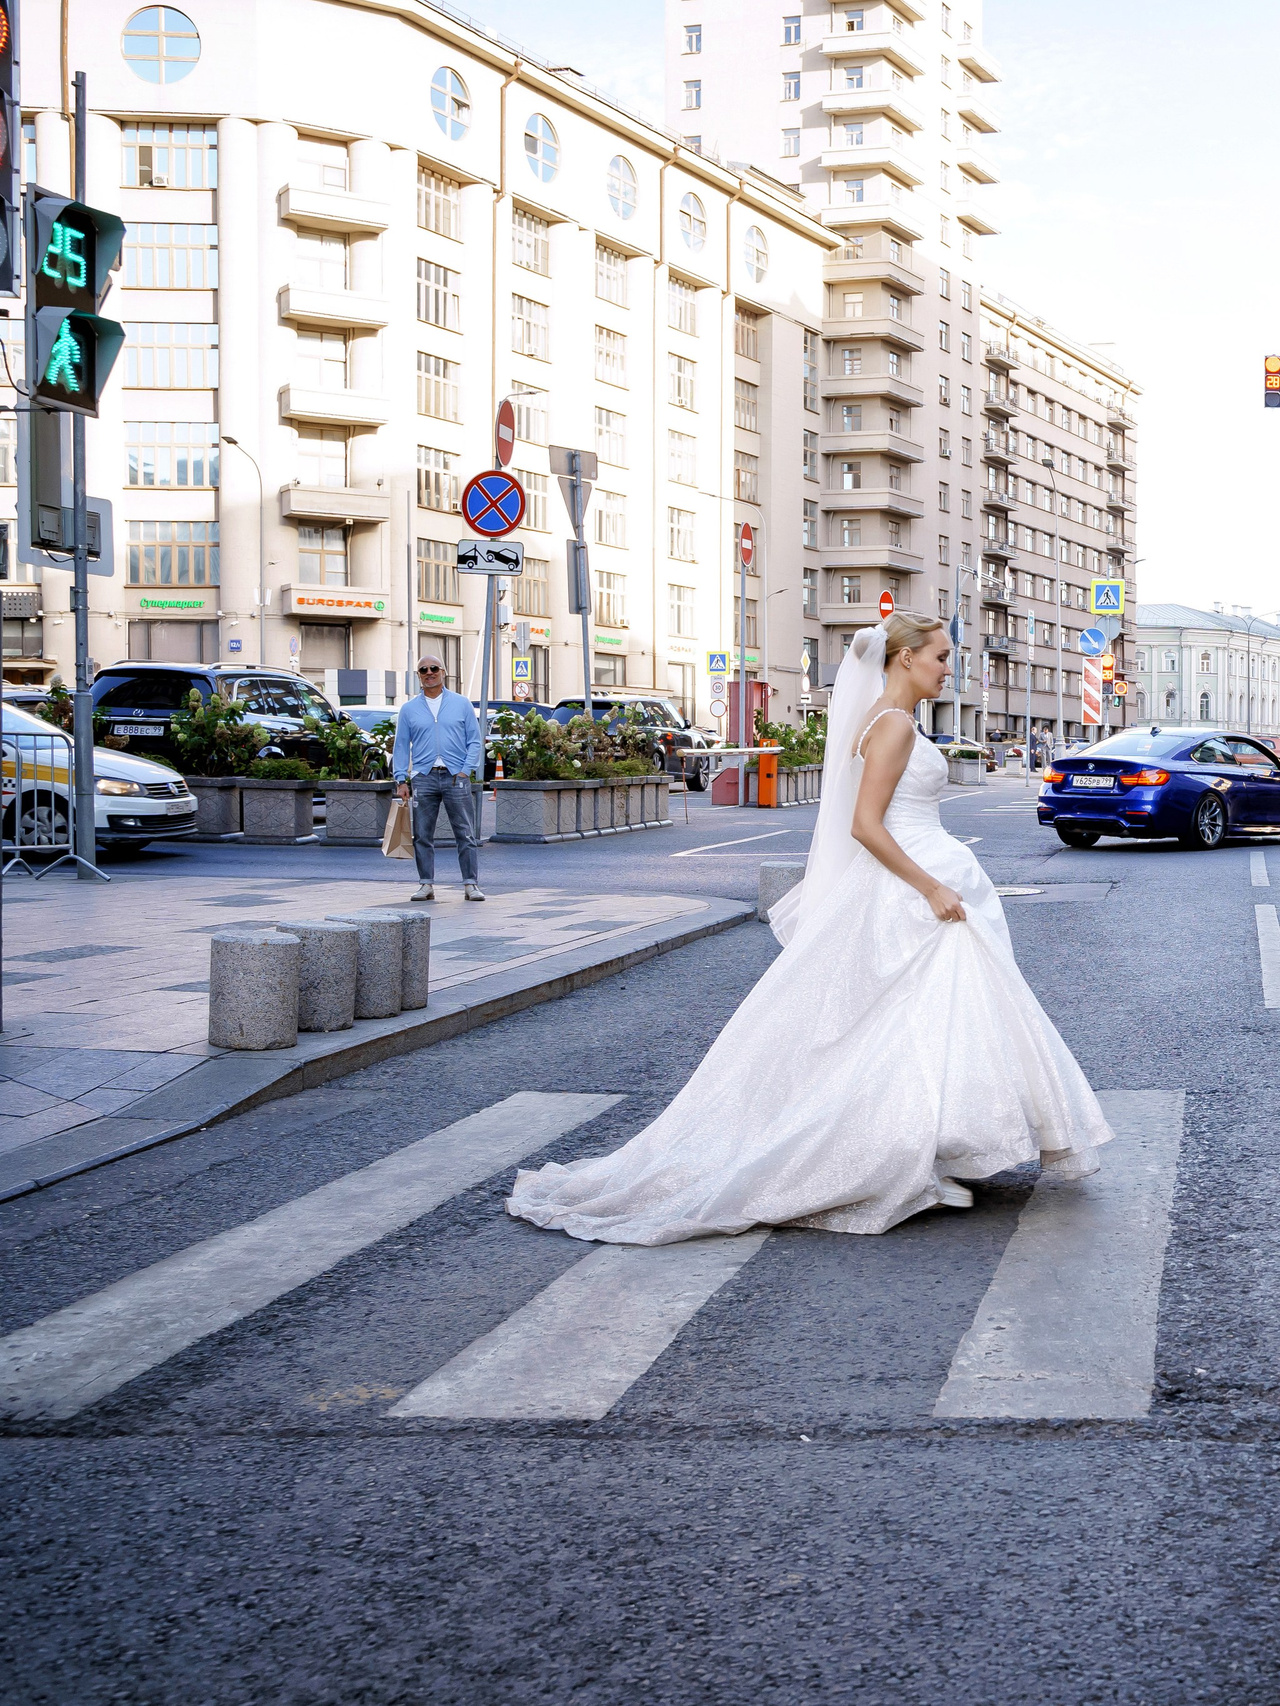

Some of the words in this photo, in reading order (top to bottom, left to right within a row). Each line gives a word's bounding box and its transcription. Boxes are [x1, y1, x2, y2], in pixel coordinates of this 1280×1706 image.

[1267, 376, 1280, 388] 28
[140, 598, 204, 609] Супермаркет
[297, 597, 373, 608] EUROSPAR
